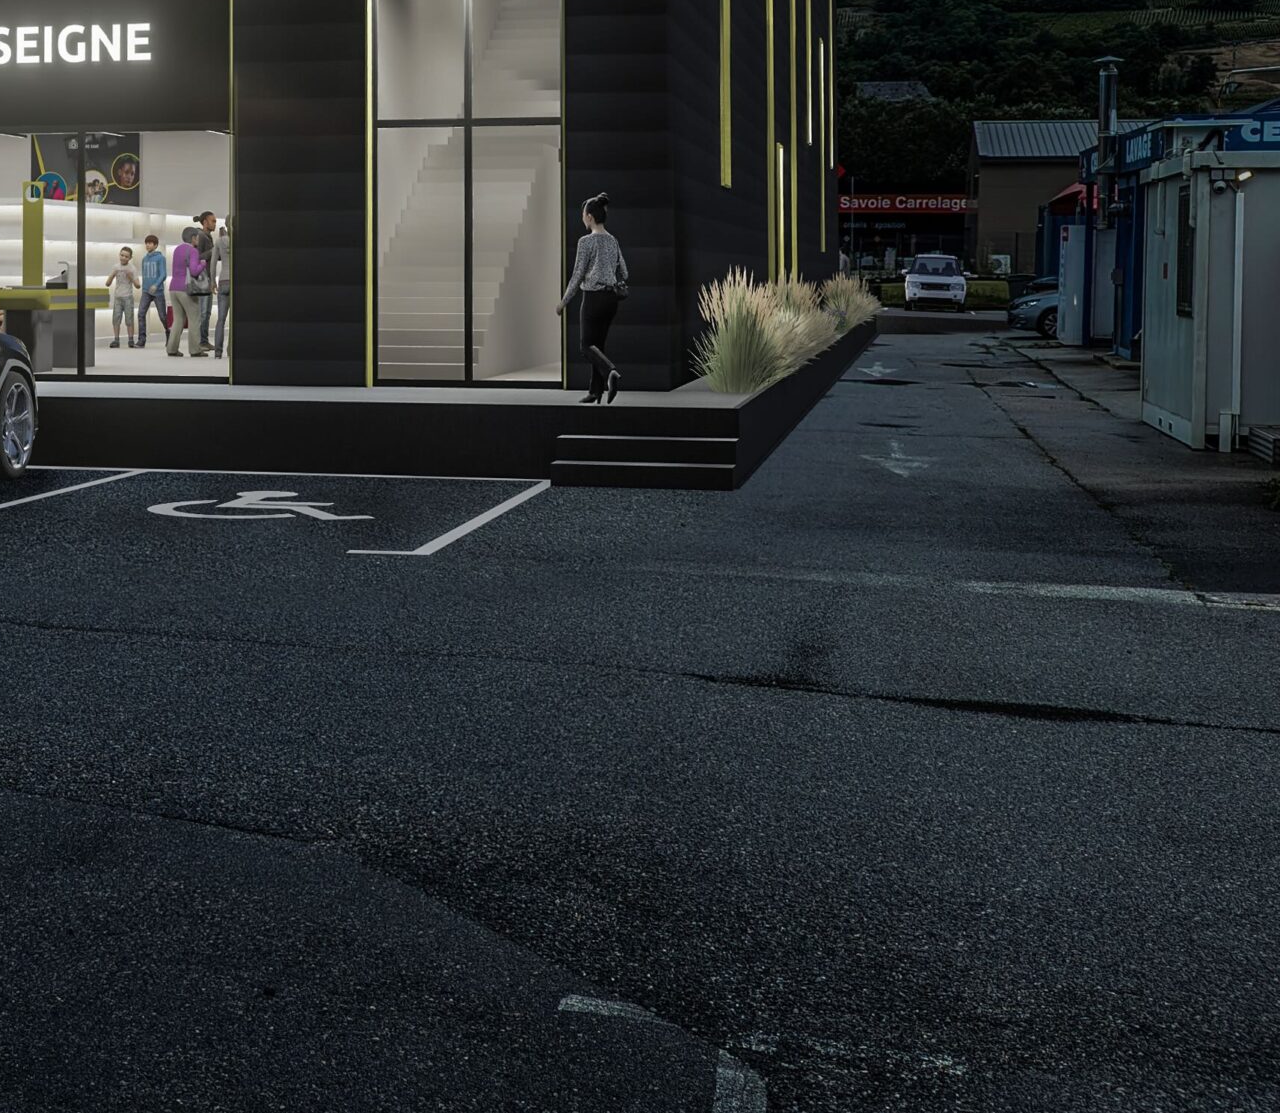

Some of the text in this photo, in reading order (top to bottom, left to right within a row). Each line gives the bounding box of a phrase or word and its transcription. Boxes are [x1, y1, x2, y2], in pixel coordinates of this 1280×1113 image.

[1125, 132, 1152, 164] LAVAGE
[840, 196, 967, 211] Savoie Carrelage
